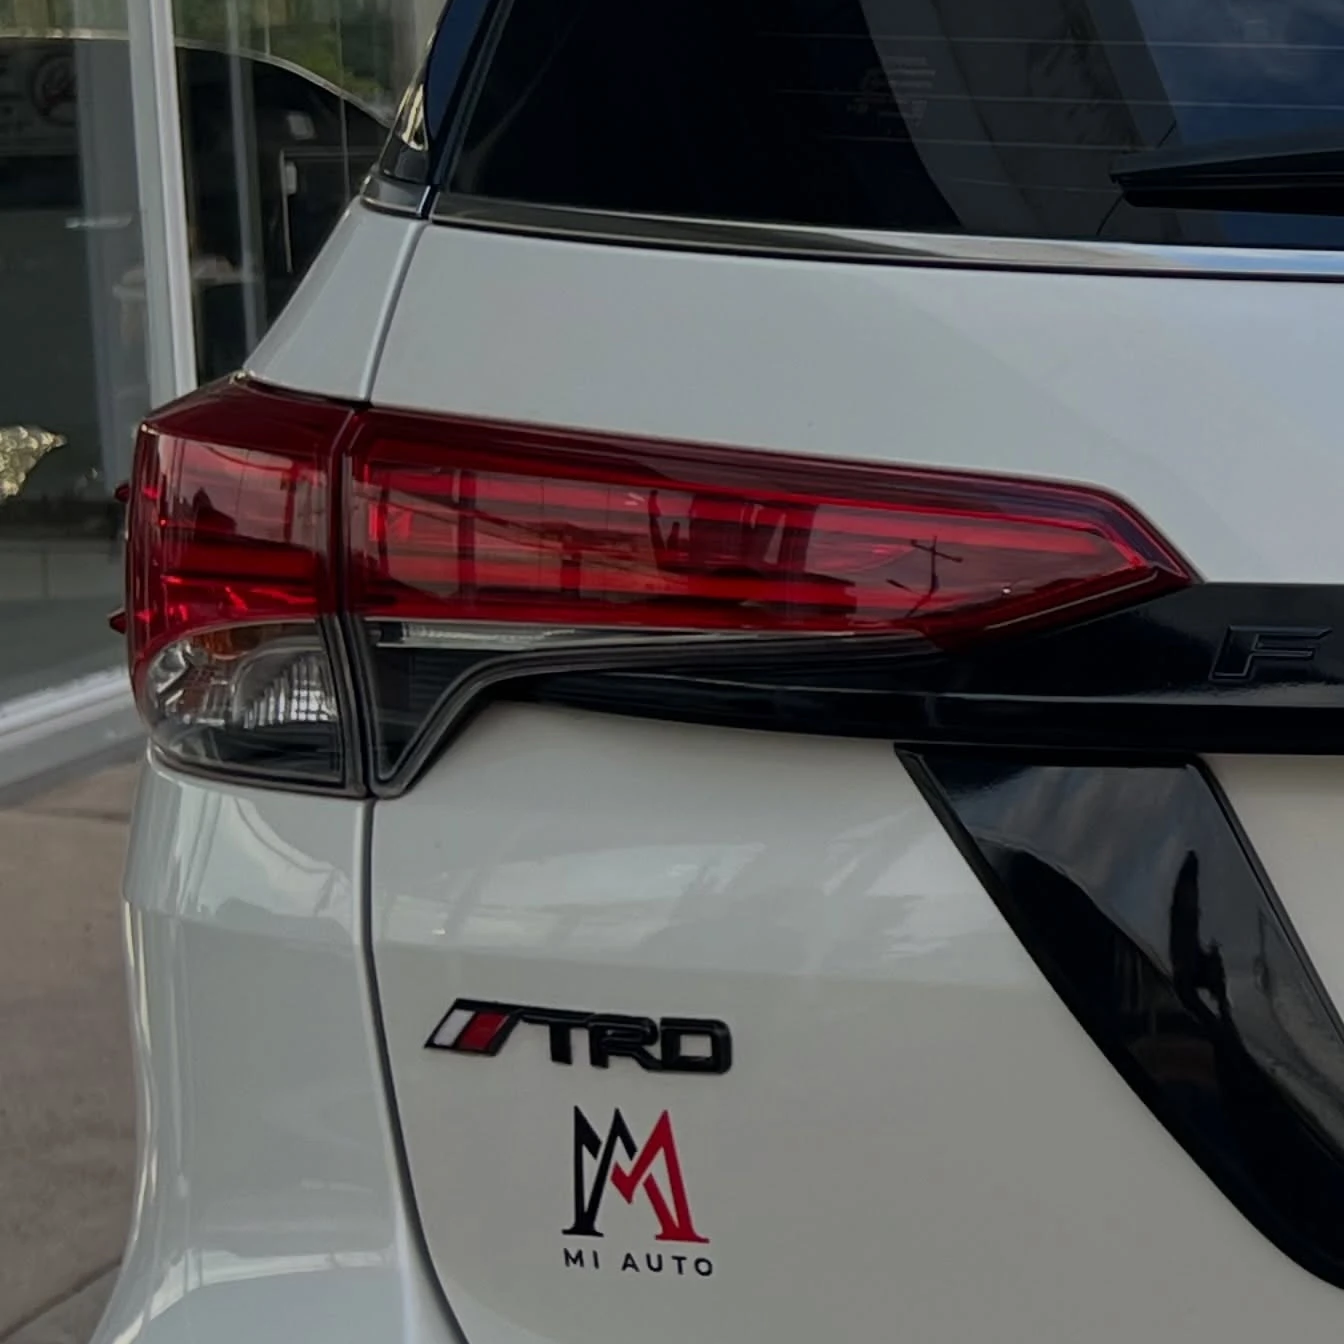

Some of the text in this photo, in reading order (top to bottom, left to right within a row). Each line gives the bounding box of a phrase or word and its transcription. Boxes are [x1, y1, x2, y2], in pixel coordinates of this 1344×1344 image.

[512, 1007, 733, 1075] TRD
[563, 1248, 714, 1277] MI AUTO
